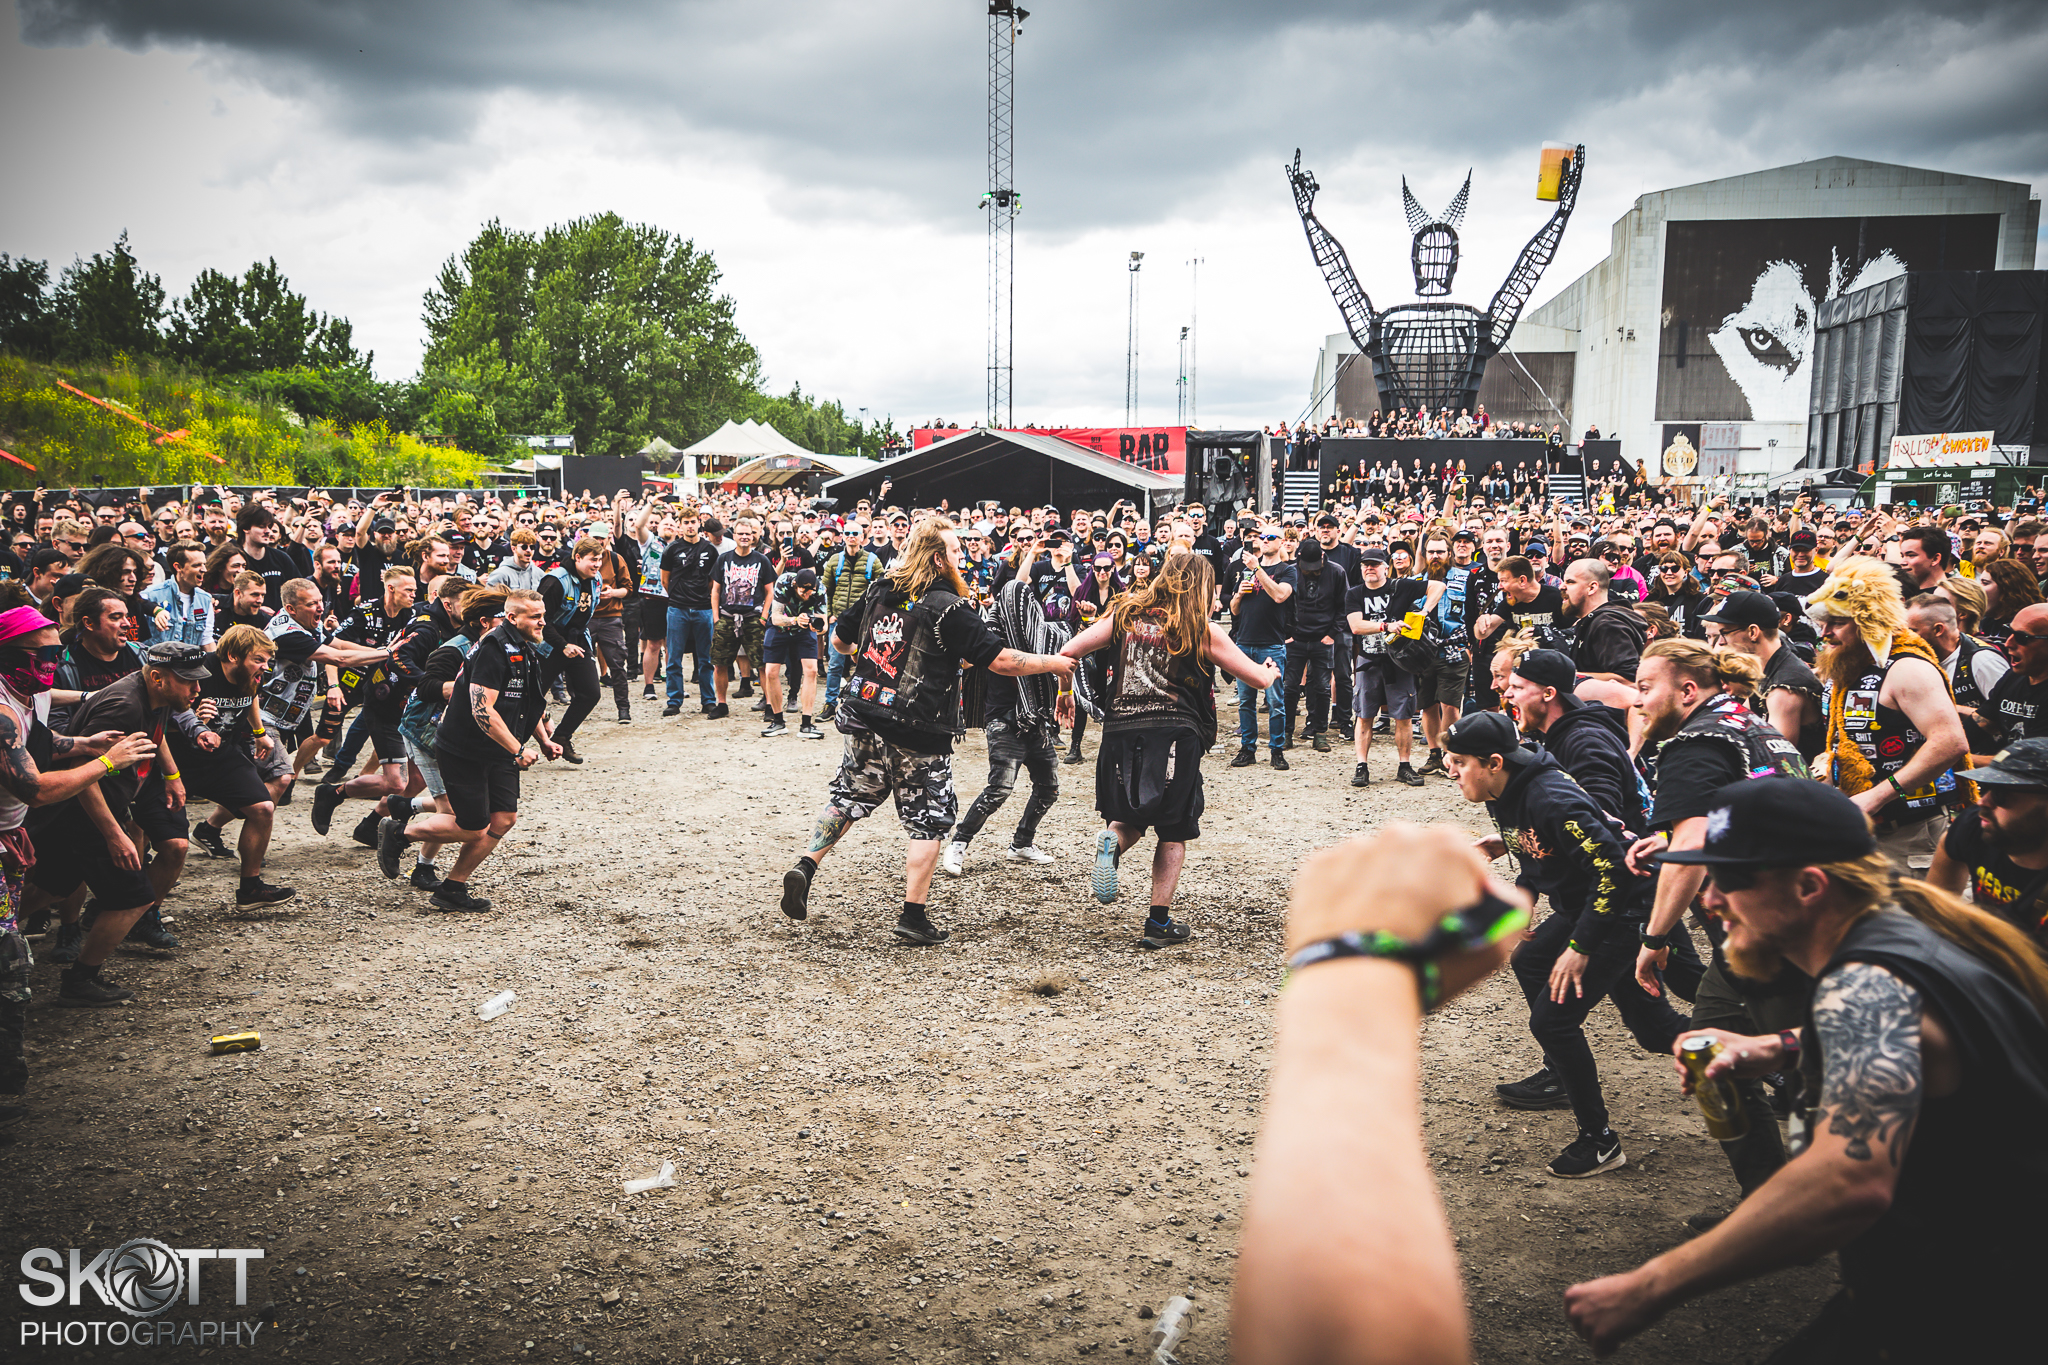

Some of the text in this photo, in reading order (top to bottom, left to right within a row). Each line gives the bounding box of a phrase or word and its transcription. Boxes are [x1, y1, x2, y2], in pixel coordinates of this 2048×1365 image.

[1120, 432, 1169, 470] BAR
[1943, 437, 1990, 454] CHICKEN
[1855, 732, 1872, 742] SHIT
